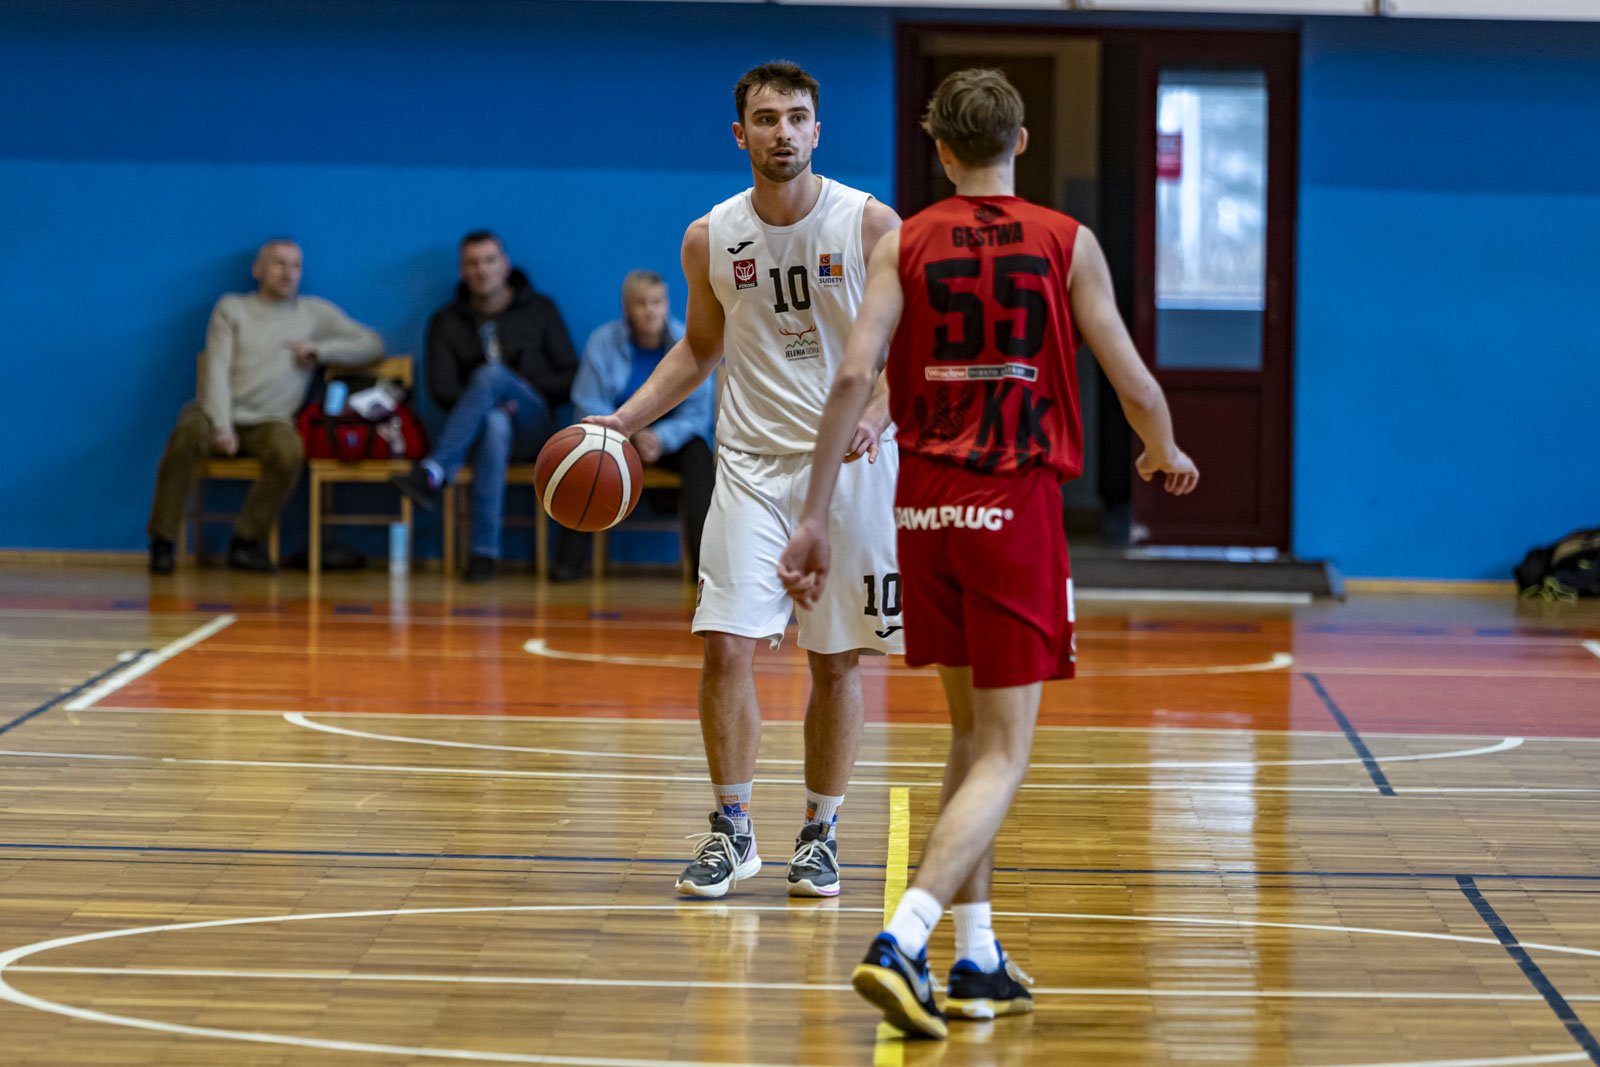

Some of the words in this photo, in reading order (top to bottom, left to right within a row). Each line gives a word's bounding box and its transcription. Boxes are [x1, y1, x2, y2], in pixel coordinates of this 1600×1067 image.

[769, 265, 812, 314] 10
[924, 254, 1049, 361] 55
[785, 349, 806, 358] JELENIA
[864, 573, 903, 617] 10
